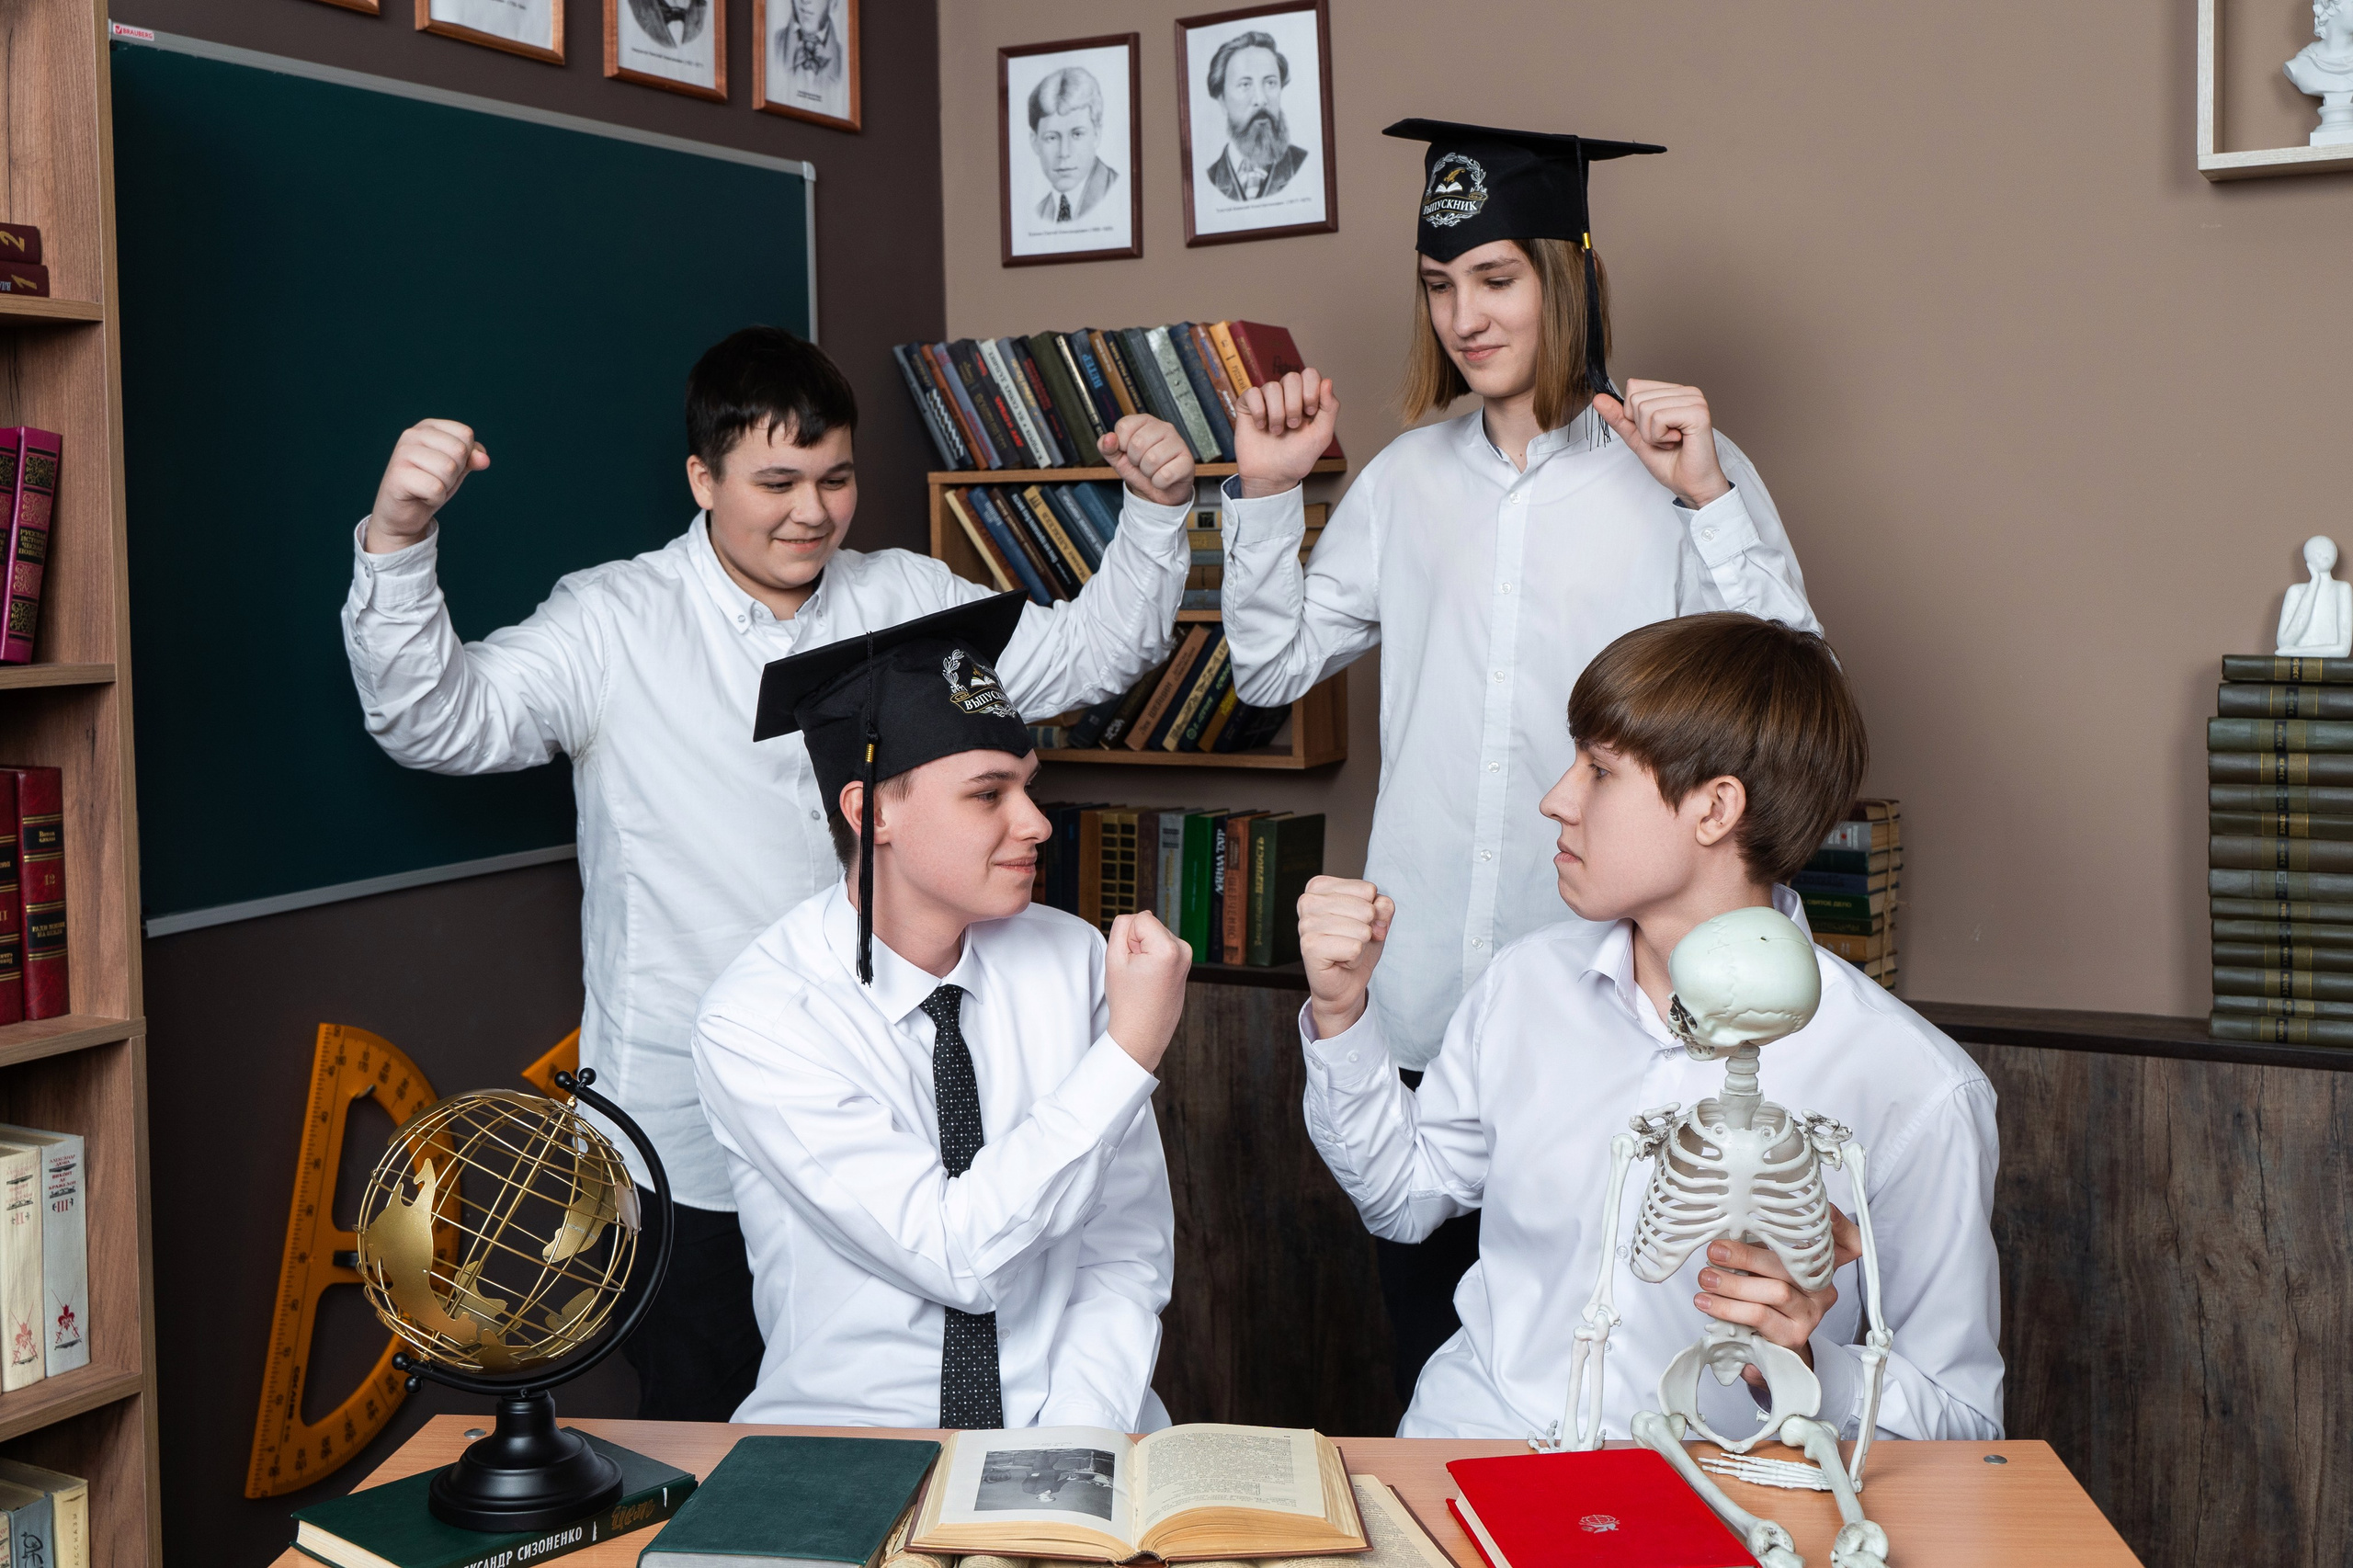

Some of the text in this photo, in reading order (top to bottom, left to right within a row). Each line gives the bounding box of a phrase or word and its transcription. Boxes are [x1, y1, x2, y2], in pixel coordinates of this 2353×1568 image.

[122, 28, 153, 39] BRAUBERG
[1081, 351, 1104, 389] ВЕТЕР
[964, 690, 1010, 710] ВЫПУСК
[1255, 835, 1264, 893] ВЕРНОСТЬ
[463, 1527, 583, 1568] САНДР СИЗОНЕНКО
